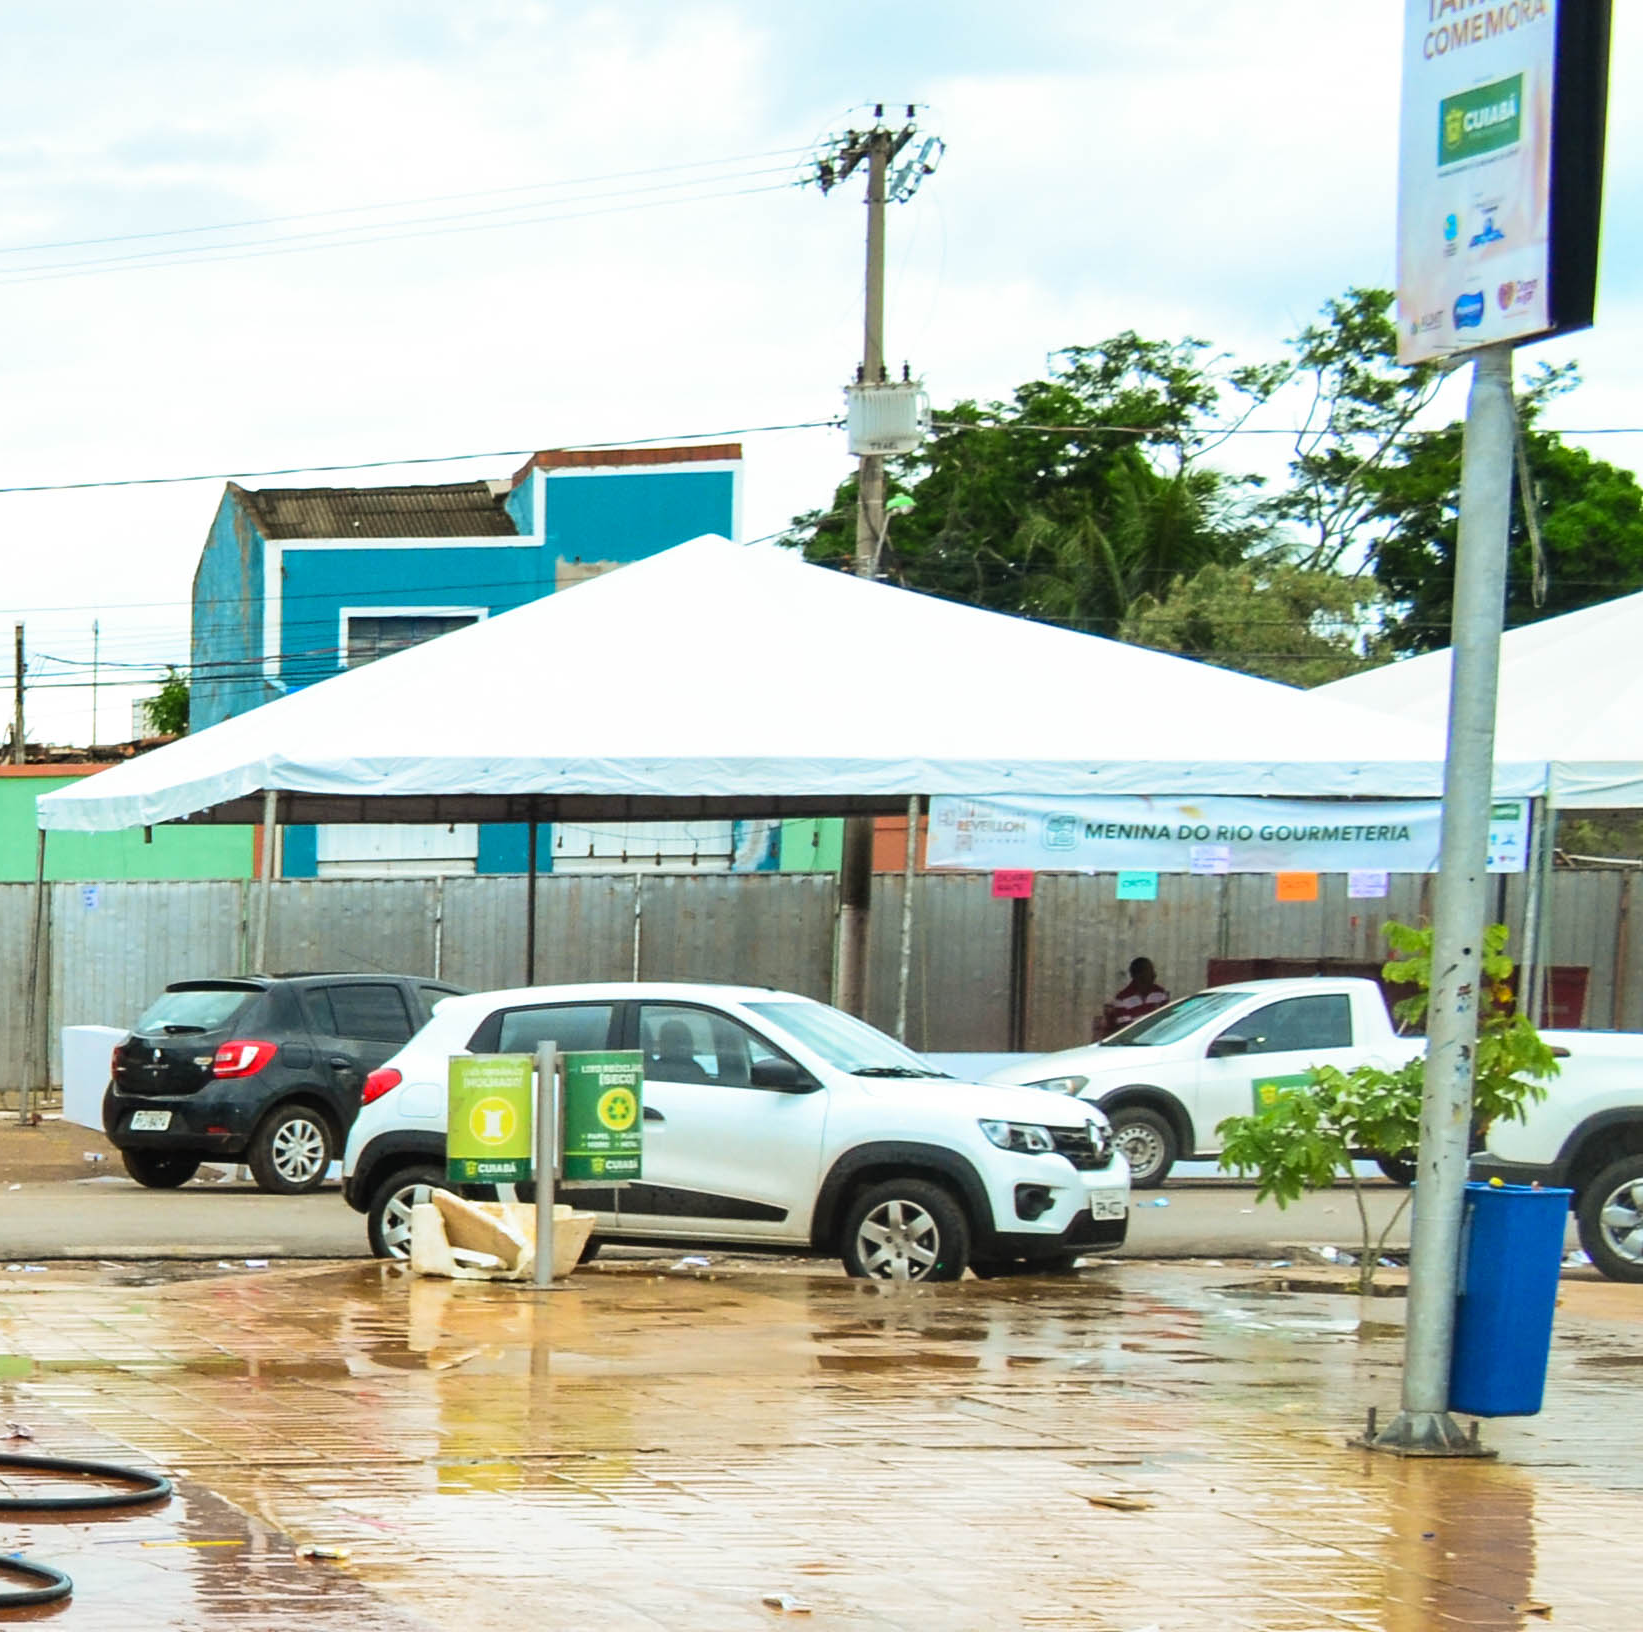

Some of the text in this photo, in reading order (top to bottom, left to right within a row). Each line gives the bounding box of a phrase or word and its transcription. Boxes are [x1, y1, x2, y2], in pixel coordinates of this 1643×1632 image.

[1084, 823, 1171, 841] MENINA
[1176, 824, 1211, 841] DO
[1216, 825, 1253, 842] RIO
[1259, 825, 1411, 842] GOURMETERIA
[477, 1161, 517, 1174] CUIABÁ
[606, 1157, 639, 1170] CUIABÁ
